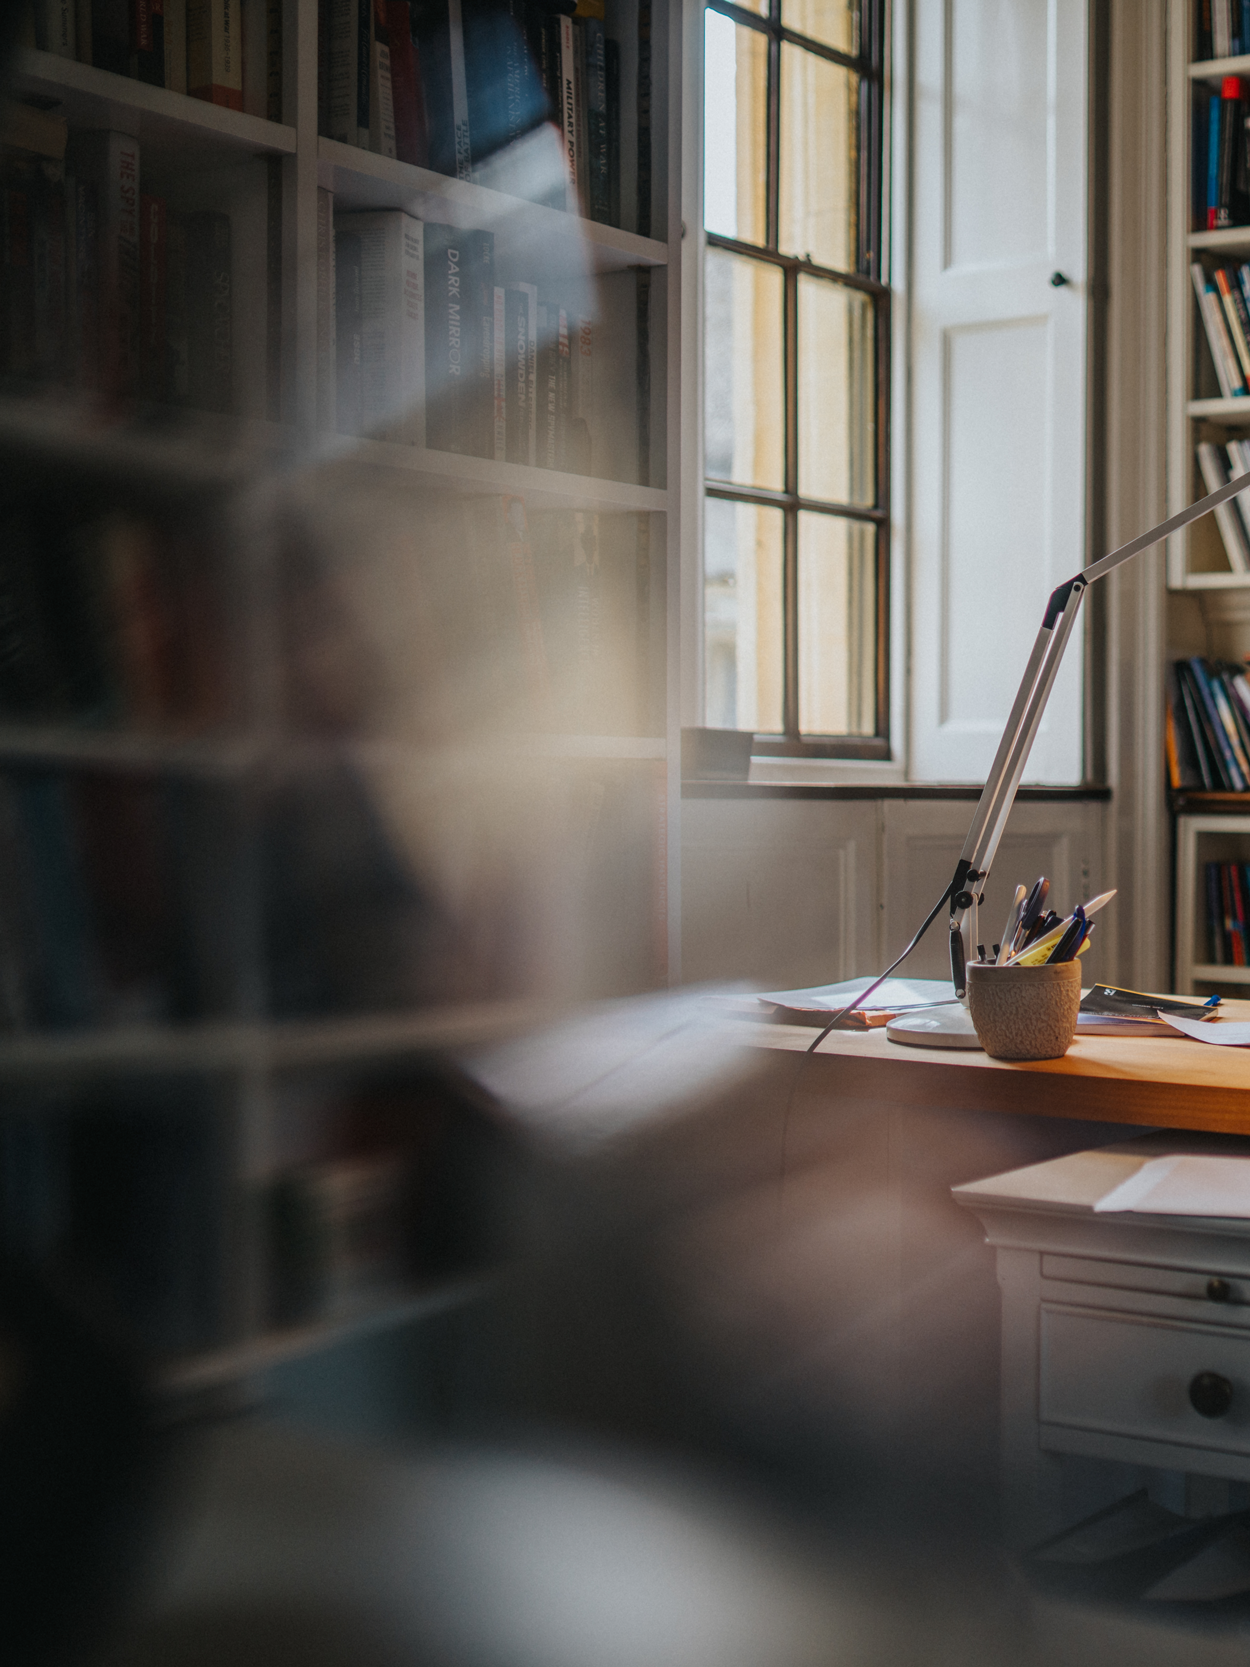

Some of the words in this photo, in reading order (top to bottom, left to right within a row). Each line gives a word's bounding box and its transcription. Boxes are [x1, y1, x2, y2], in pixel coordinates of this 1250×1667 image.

[59, 6, 71, 45] Summers
[139, 23, 148, 45] WAR
[595, 32, 605, 111] CHILDREN
[565, 77, 574, 136] MILITARY
[120, 150, 135, 181] THE
[567, 139, 576, 184] POWER
[120, 184, 135, 217] SPY
[447, 248, 460, 296] DARK
[447, 302, 460, 374] MIRROR
[479, 315, 493, 378] Eavesdropping
[579, 318, 591, 356] 1983
[516, 315, 527, 407] SNOWDEN
